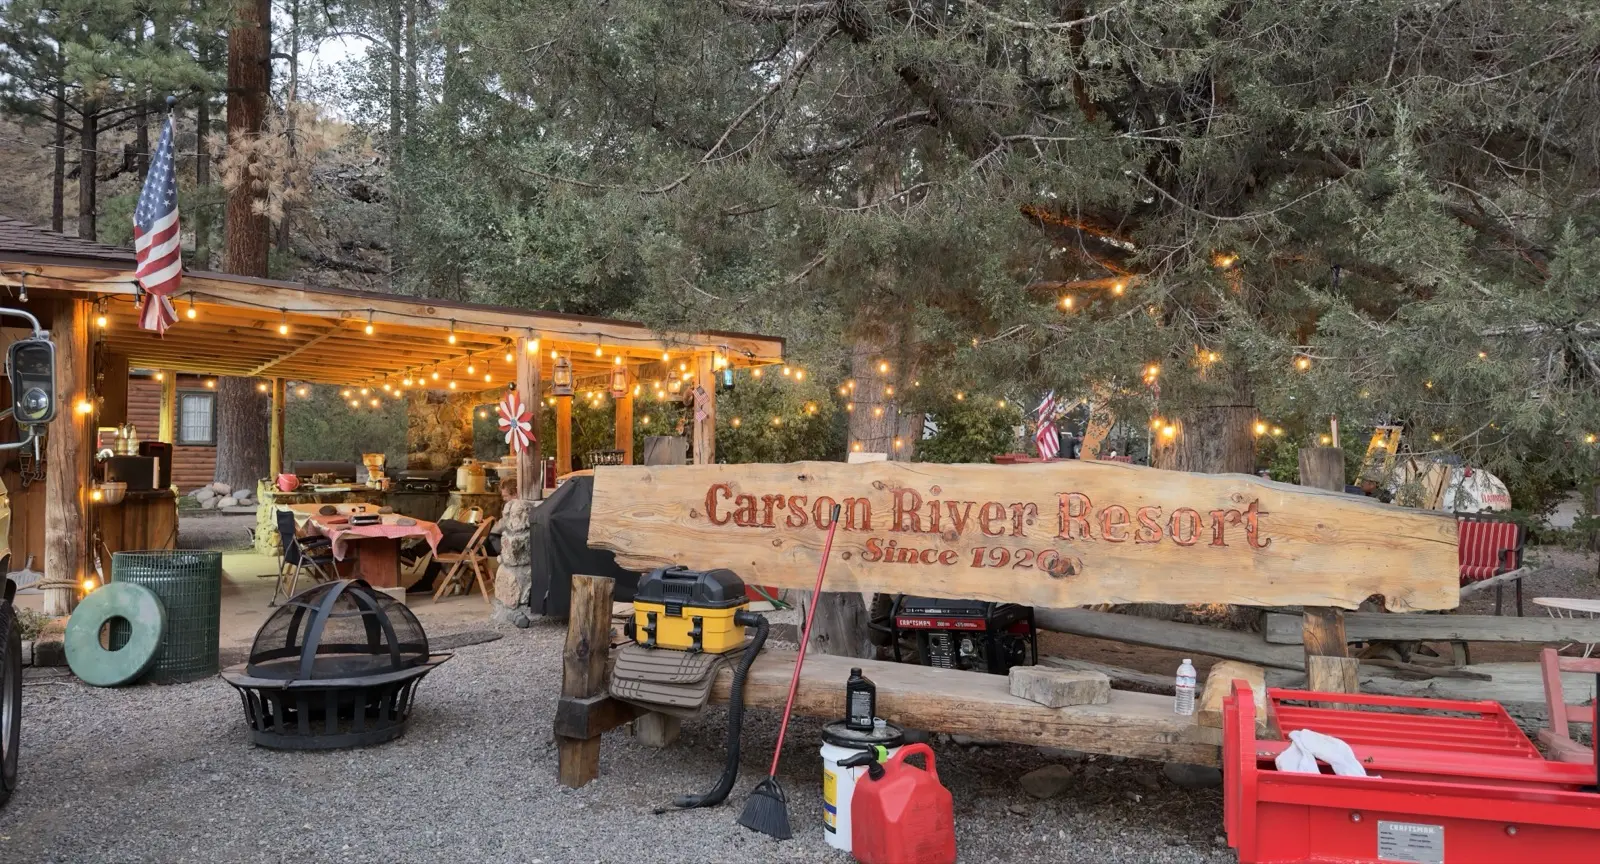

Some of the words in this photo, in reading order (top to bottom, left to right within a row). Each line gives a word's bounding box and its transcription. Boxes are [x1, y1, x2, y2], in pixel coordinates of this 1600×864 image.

[705, 483, 873, 531] Carson
[889, 485, 1038, 537] River
[1054, 491, 1272, 549] Resort
[861, 537, 958, 566] Since
[1389, 824, 1435, 833] CRAFTSMAN
